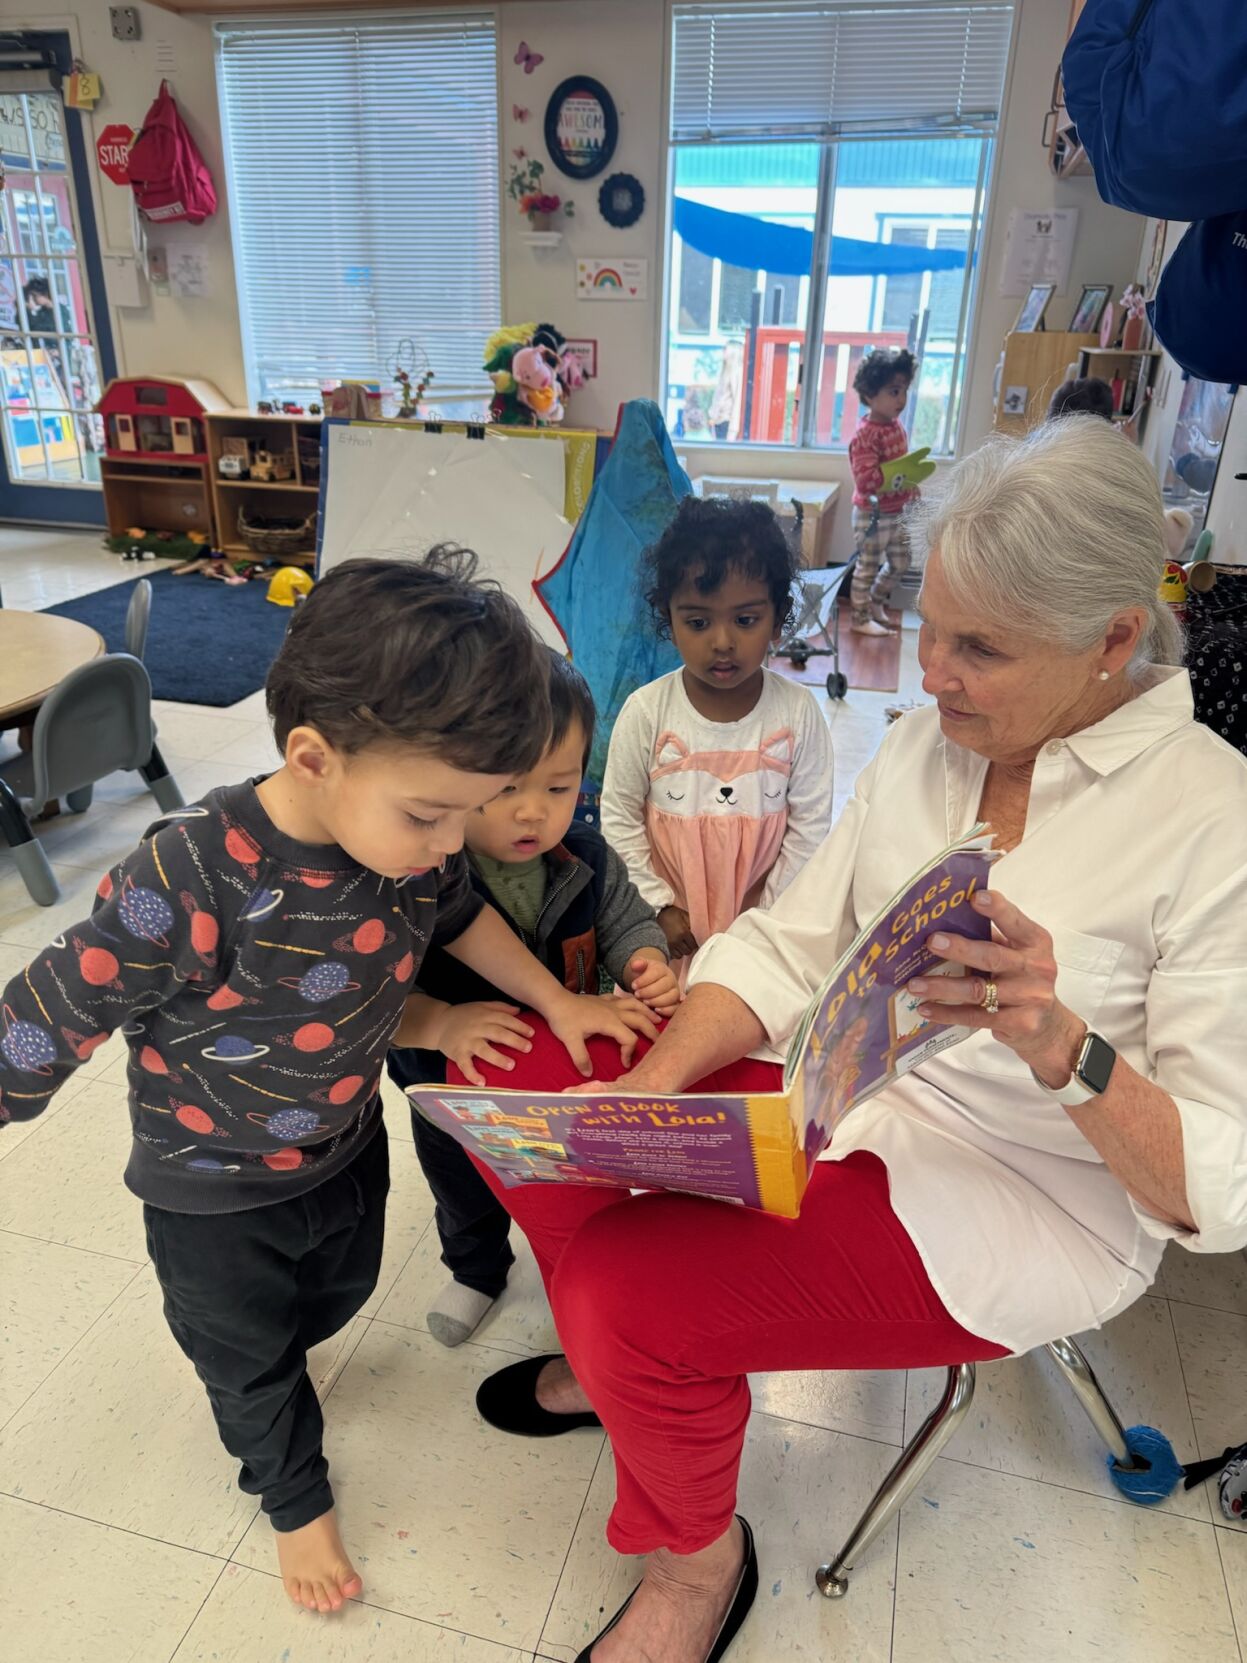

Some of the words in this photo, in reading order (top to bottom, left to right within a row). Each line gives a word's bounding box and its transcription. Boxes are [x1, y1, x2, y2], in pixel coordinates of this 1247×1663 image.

[890, 875, 953, 935] Goes
[598, 1104, 615, 1113] a
[618, 1101, 681, 1113] book
[647, 1111, 727, 1127] Lola!
